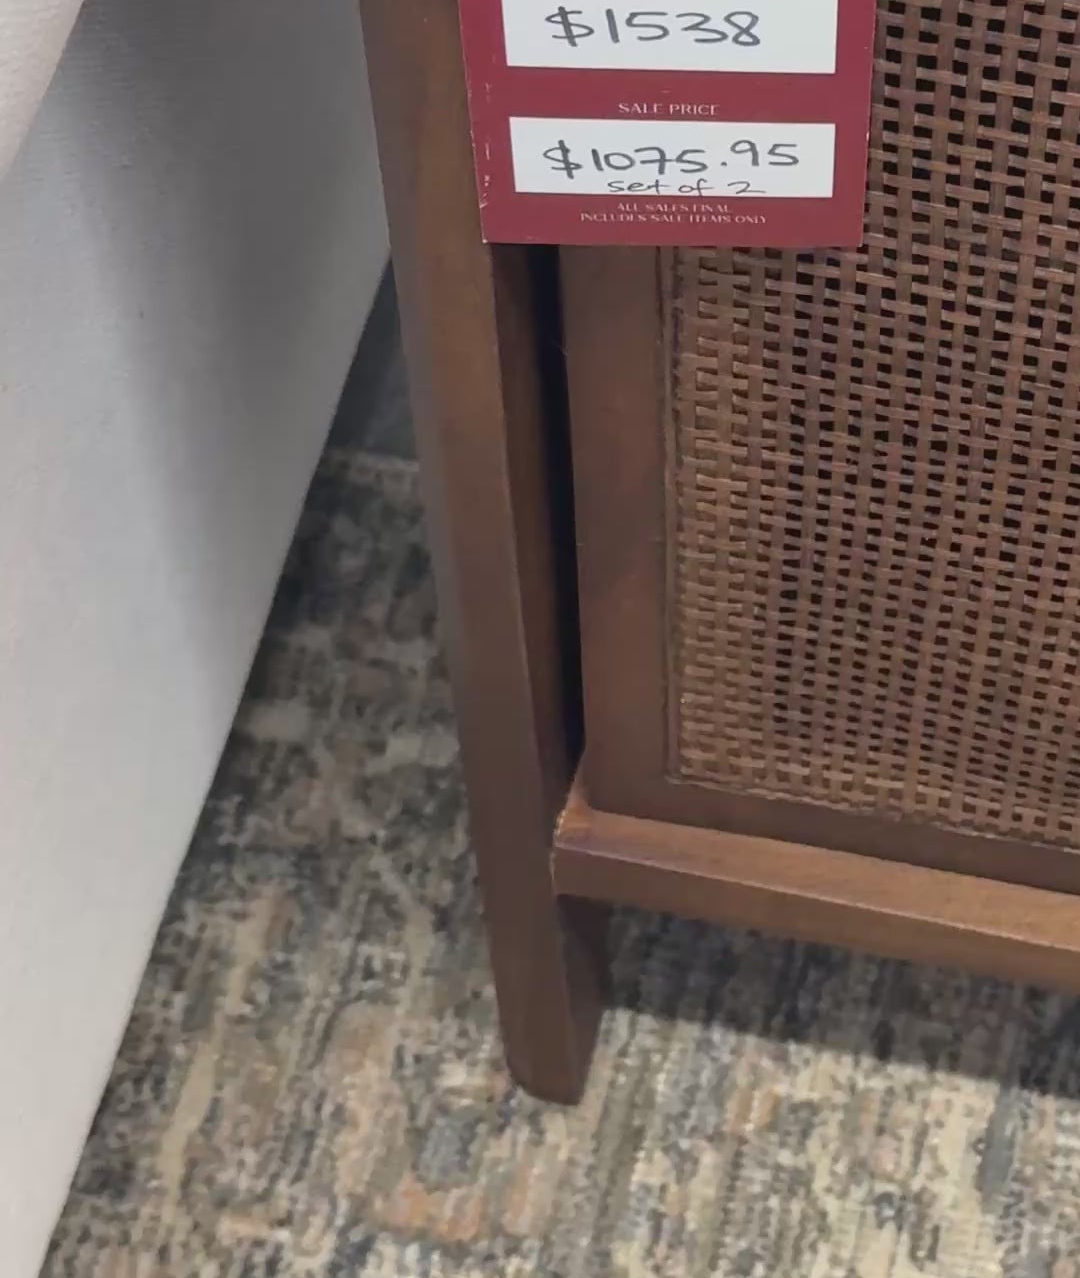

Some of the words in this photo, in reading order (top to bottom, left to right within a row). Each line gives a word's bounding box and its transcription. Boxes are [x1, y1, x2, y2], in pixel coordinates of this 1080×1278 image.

[544, 5, 761, 48] $1538
[617, 102, 664, 115] SALE
[669, 103, 720, 117] PRICE
[543, 139, 800, 180] $1075.95
[607, 179, 670, 195] set
[678, 178, 715, 197] of
[727, 180, 767, 195] 2
